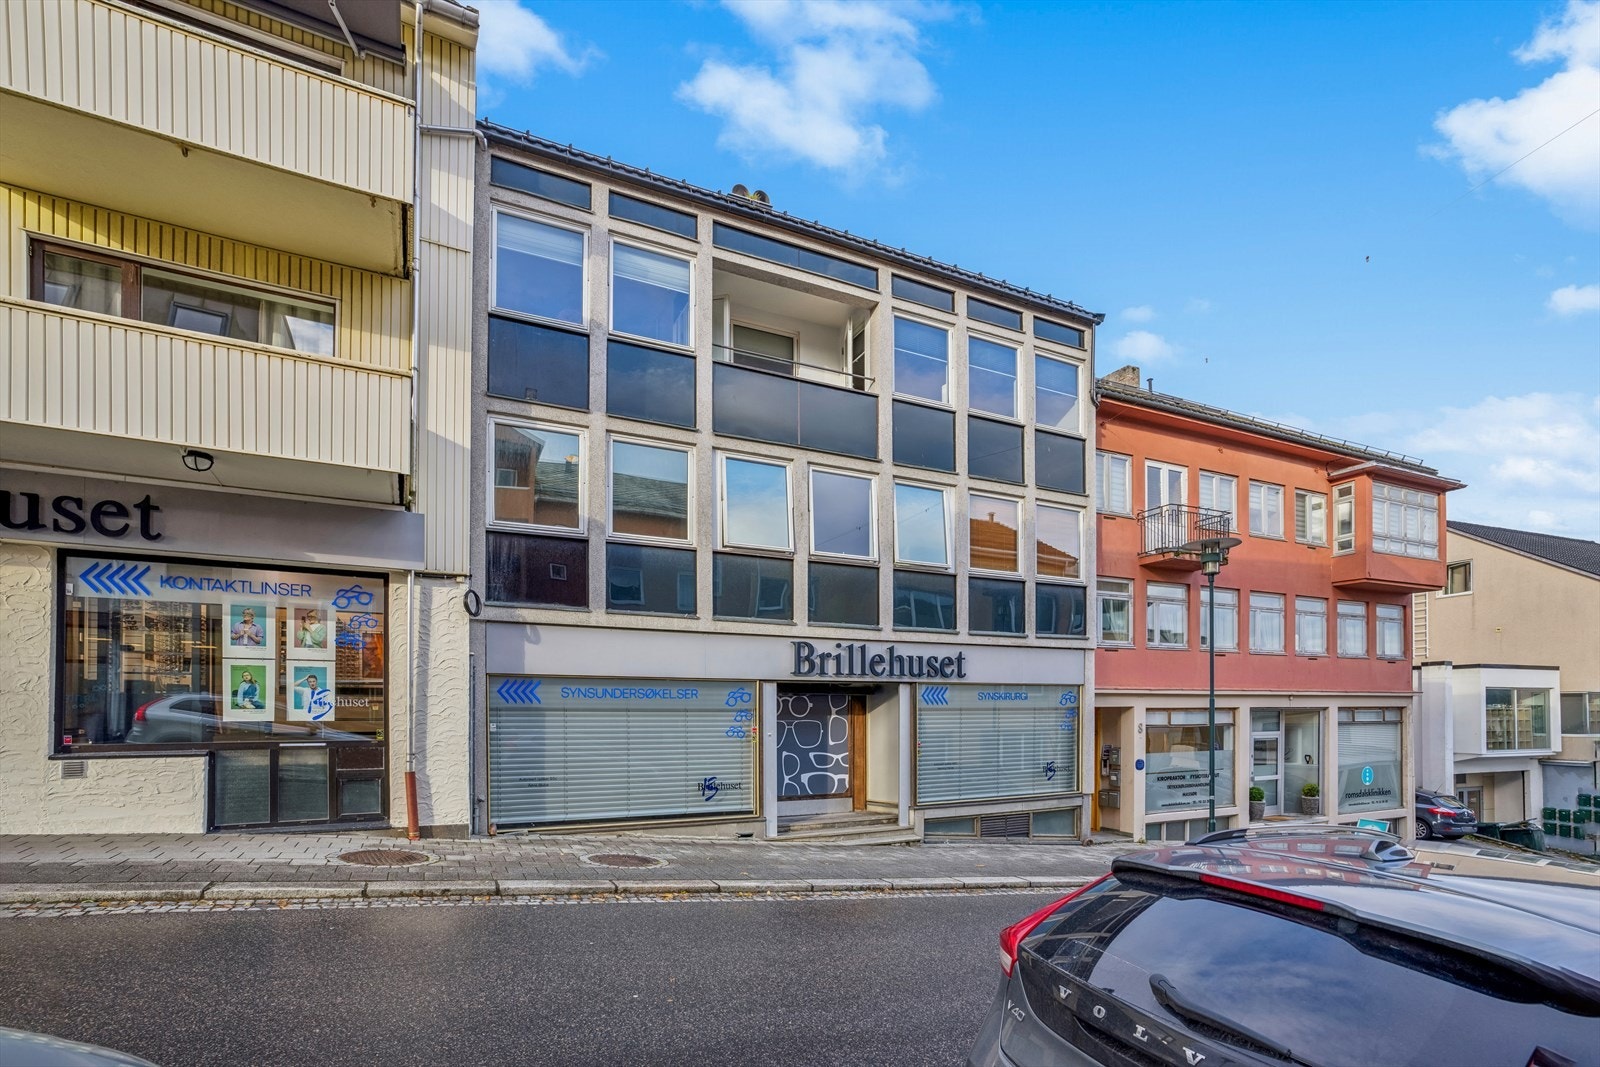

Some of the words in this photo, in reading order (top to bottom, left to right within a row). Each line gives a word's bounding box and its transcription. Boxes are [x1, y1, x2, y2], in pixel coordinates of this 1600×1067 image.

[159, 574, 312, 597] KONTAKTLINSER
[790, 641, 967, 679] Brillehuset
[560, 686, 699, 699] SYNSUNDERSØKELSER
[977, 691, 1028, 701] SYNSKIRURGI
[1006, 999, 1026, 1022] V40
